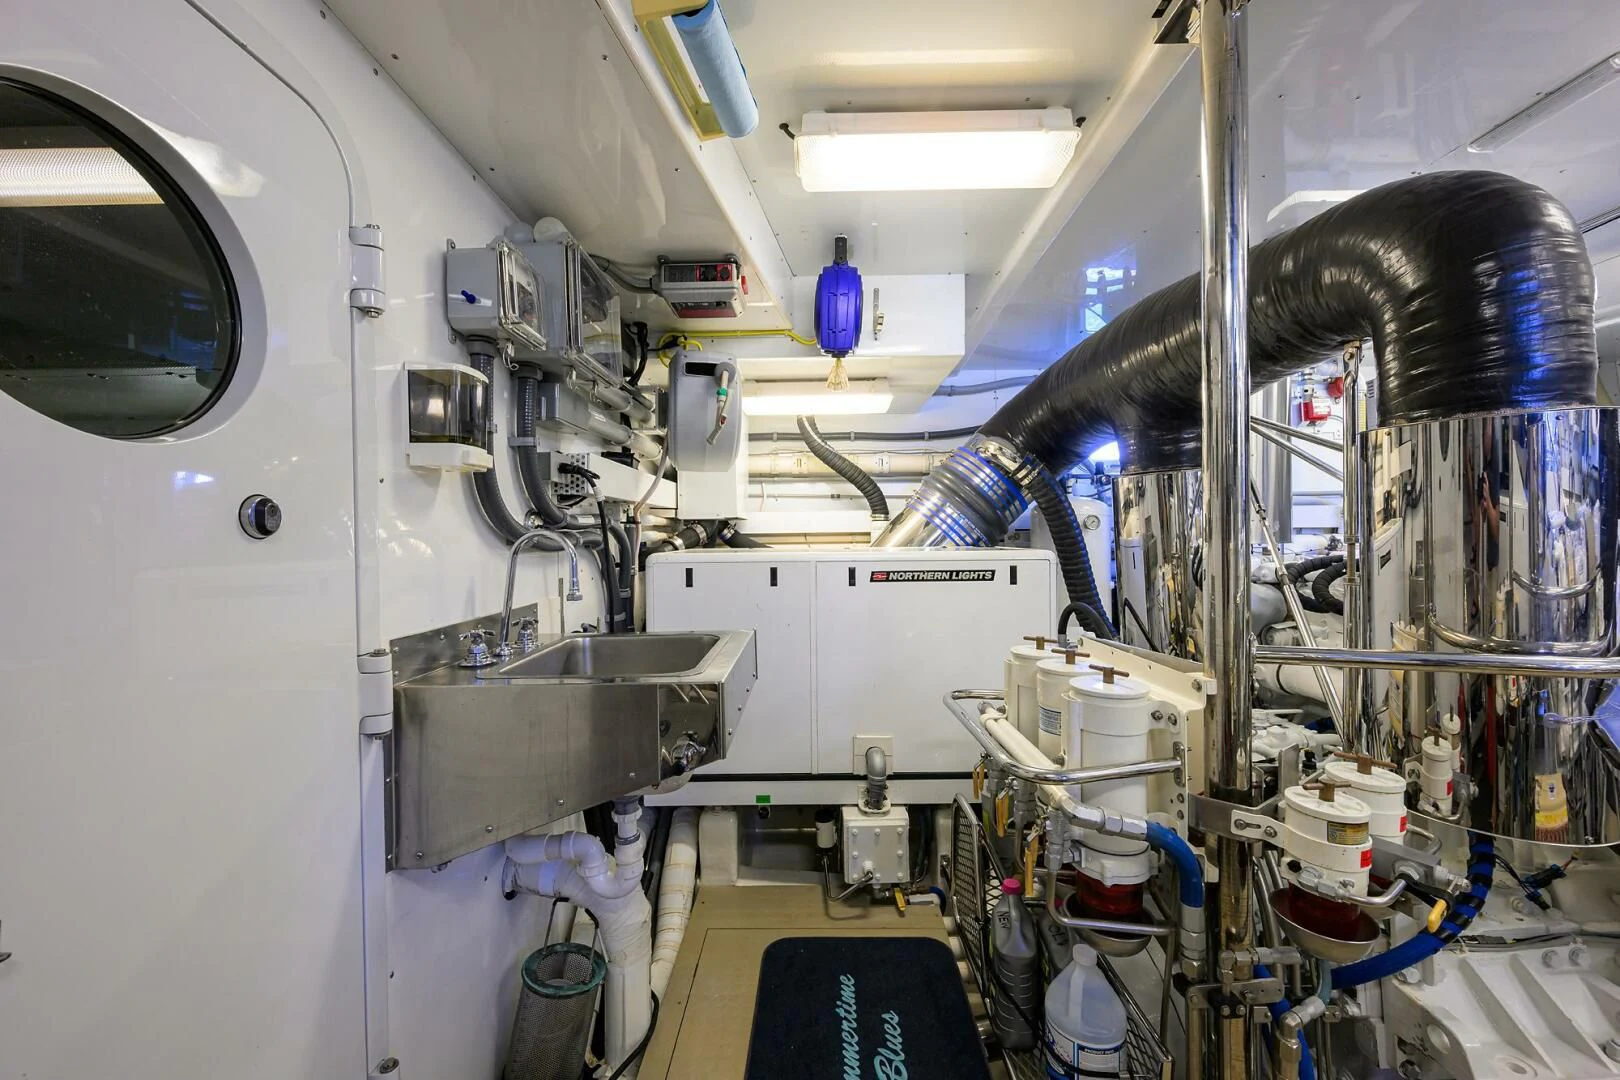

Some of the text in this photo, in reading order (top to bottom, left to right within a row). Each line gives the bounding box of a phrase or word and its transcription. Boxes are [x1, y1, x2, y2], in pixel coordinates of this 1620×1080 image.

[888, 571, 993, 581] NORTHERN LIGHTS
[873, 1010, 909, 1080] Blues
